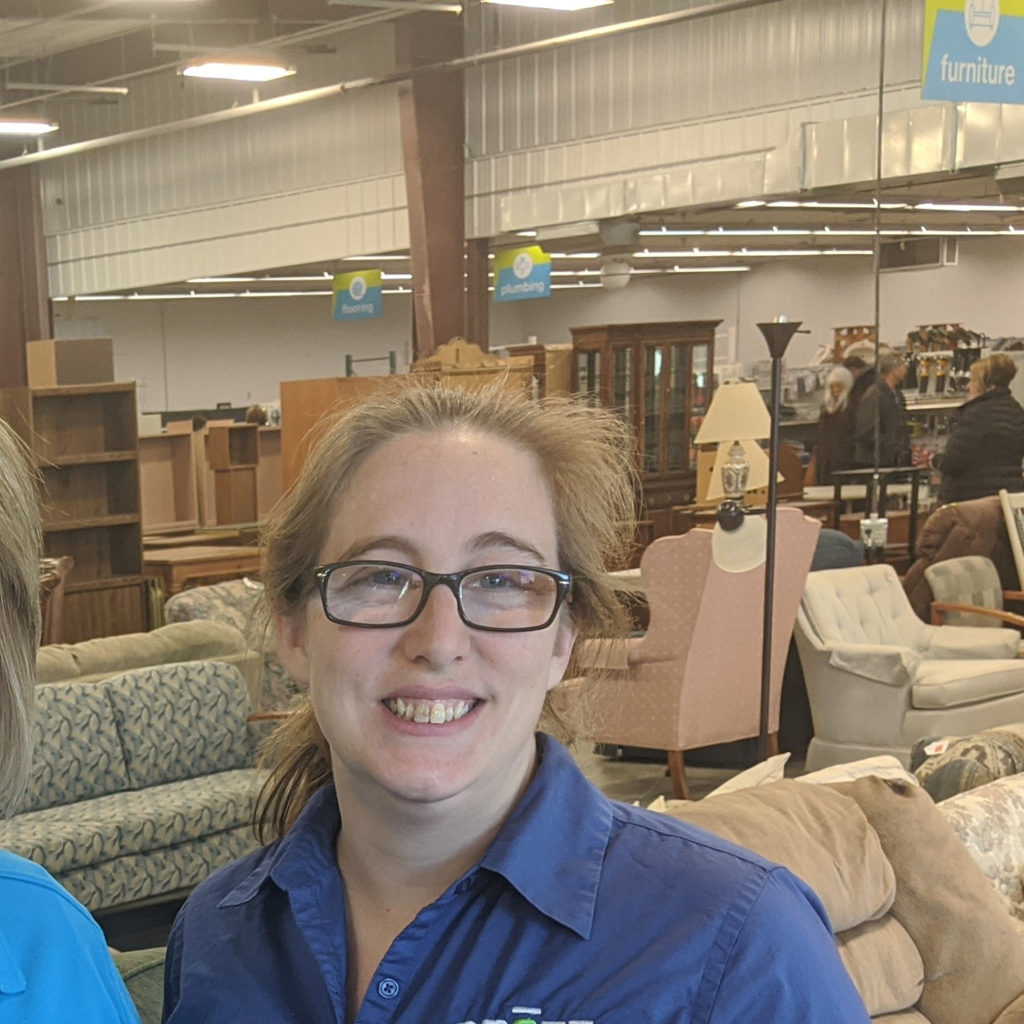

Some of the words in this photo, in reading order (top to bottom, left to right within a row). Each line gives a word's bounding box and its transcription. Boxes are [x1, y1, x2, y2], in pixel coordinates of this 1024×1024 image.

[941, 53, 1015, 86] furniture
[500, 281, 545, 297] plumbing
[341, 302, 374, 315] flooring
